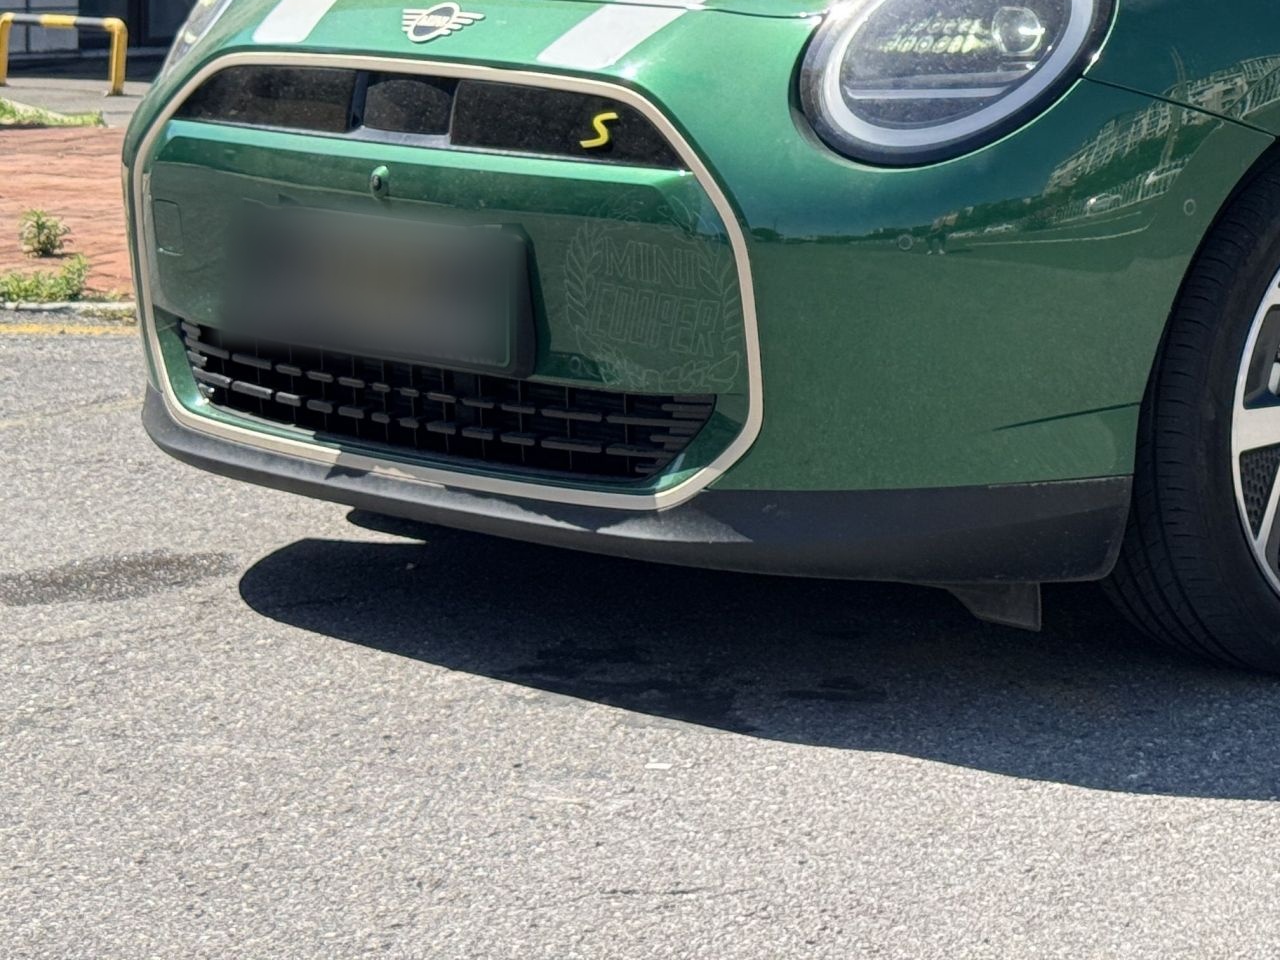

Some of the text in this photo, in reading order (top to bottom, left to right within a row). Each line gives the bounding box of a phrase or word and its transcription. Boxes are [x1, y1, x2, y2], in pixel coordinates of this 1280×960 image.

[580, 112, 619, 148] S
[602, 236, 698, 290] MINI
[589, 281, 721, 358] COOPER
